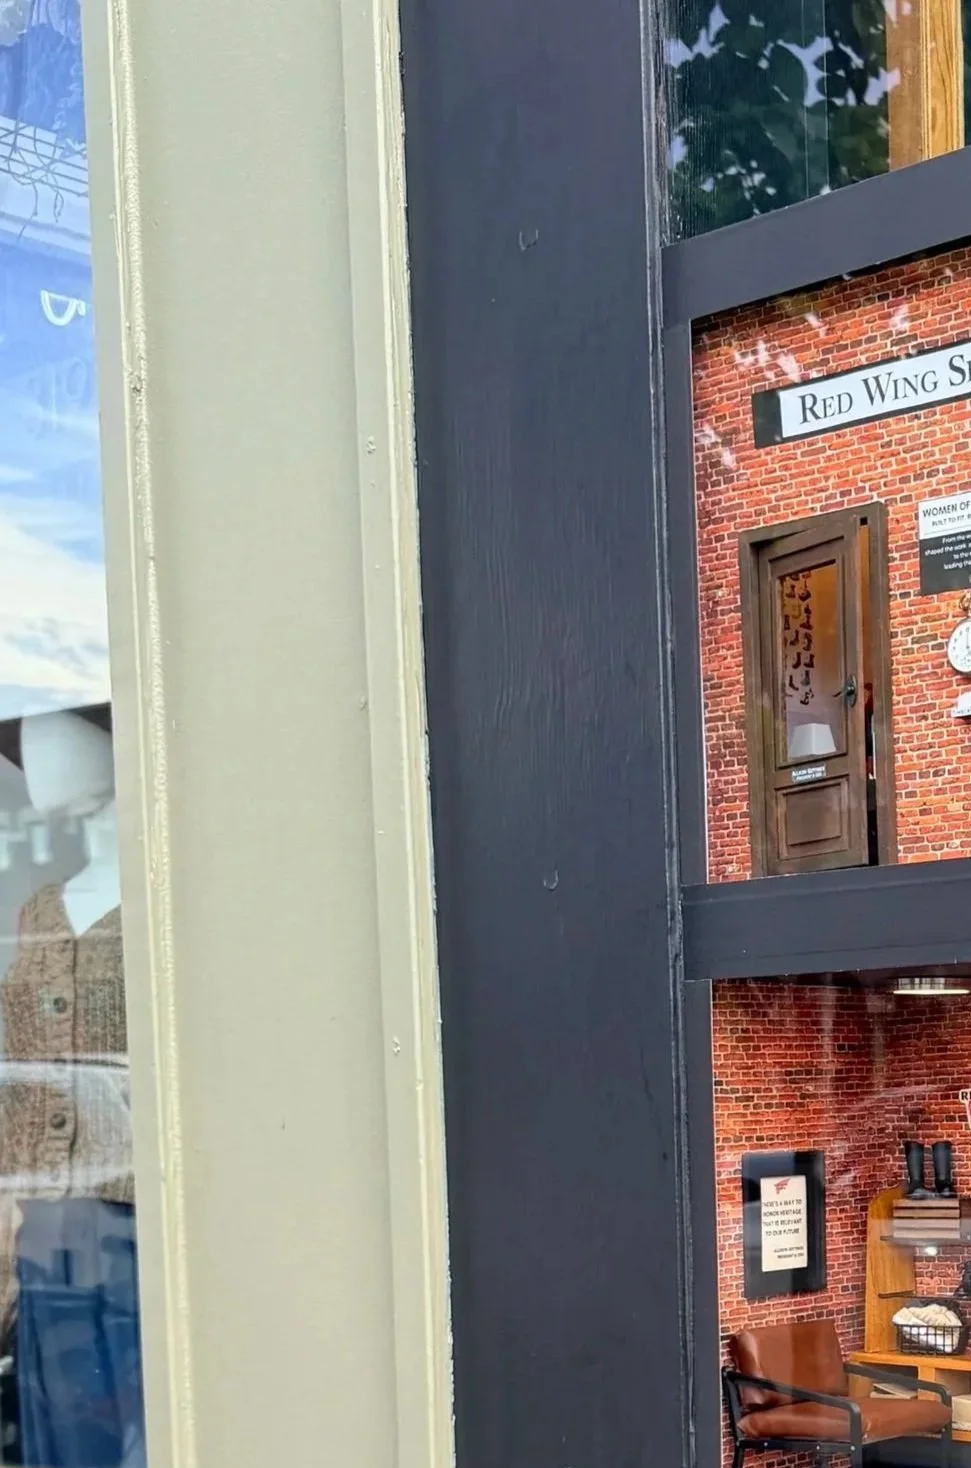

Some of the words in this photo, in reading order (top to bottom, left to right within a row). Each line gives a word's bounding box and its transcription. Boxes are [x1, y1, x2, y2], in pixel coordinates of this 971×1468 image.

[799, 392, 853, 425] RED
[862, 370, 938, 406] WING
[922, 503, 957, 518] WOMEN
[960, 501, 971, 510] OF
